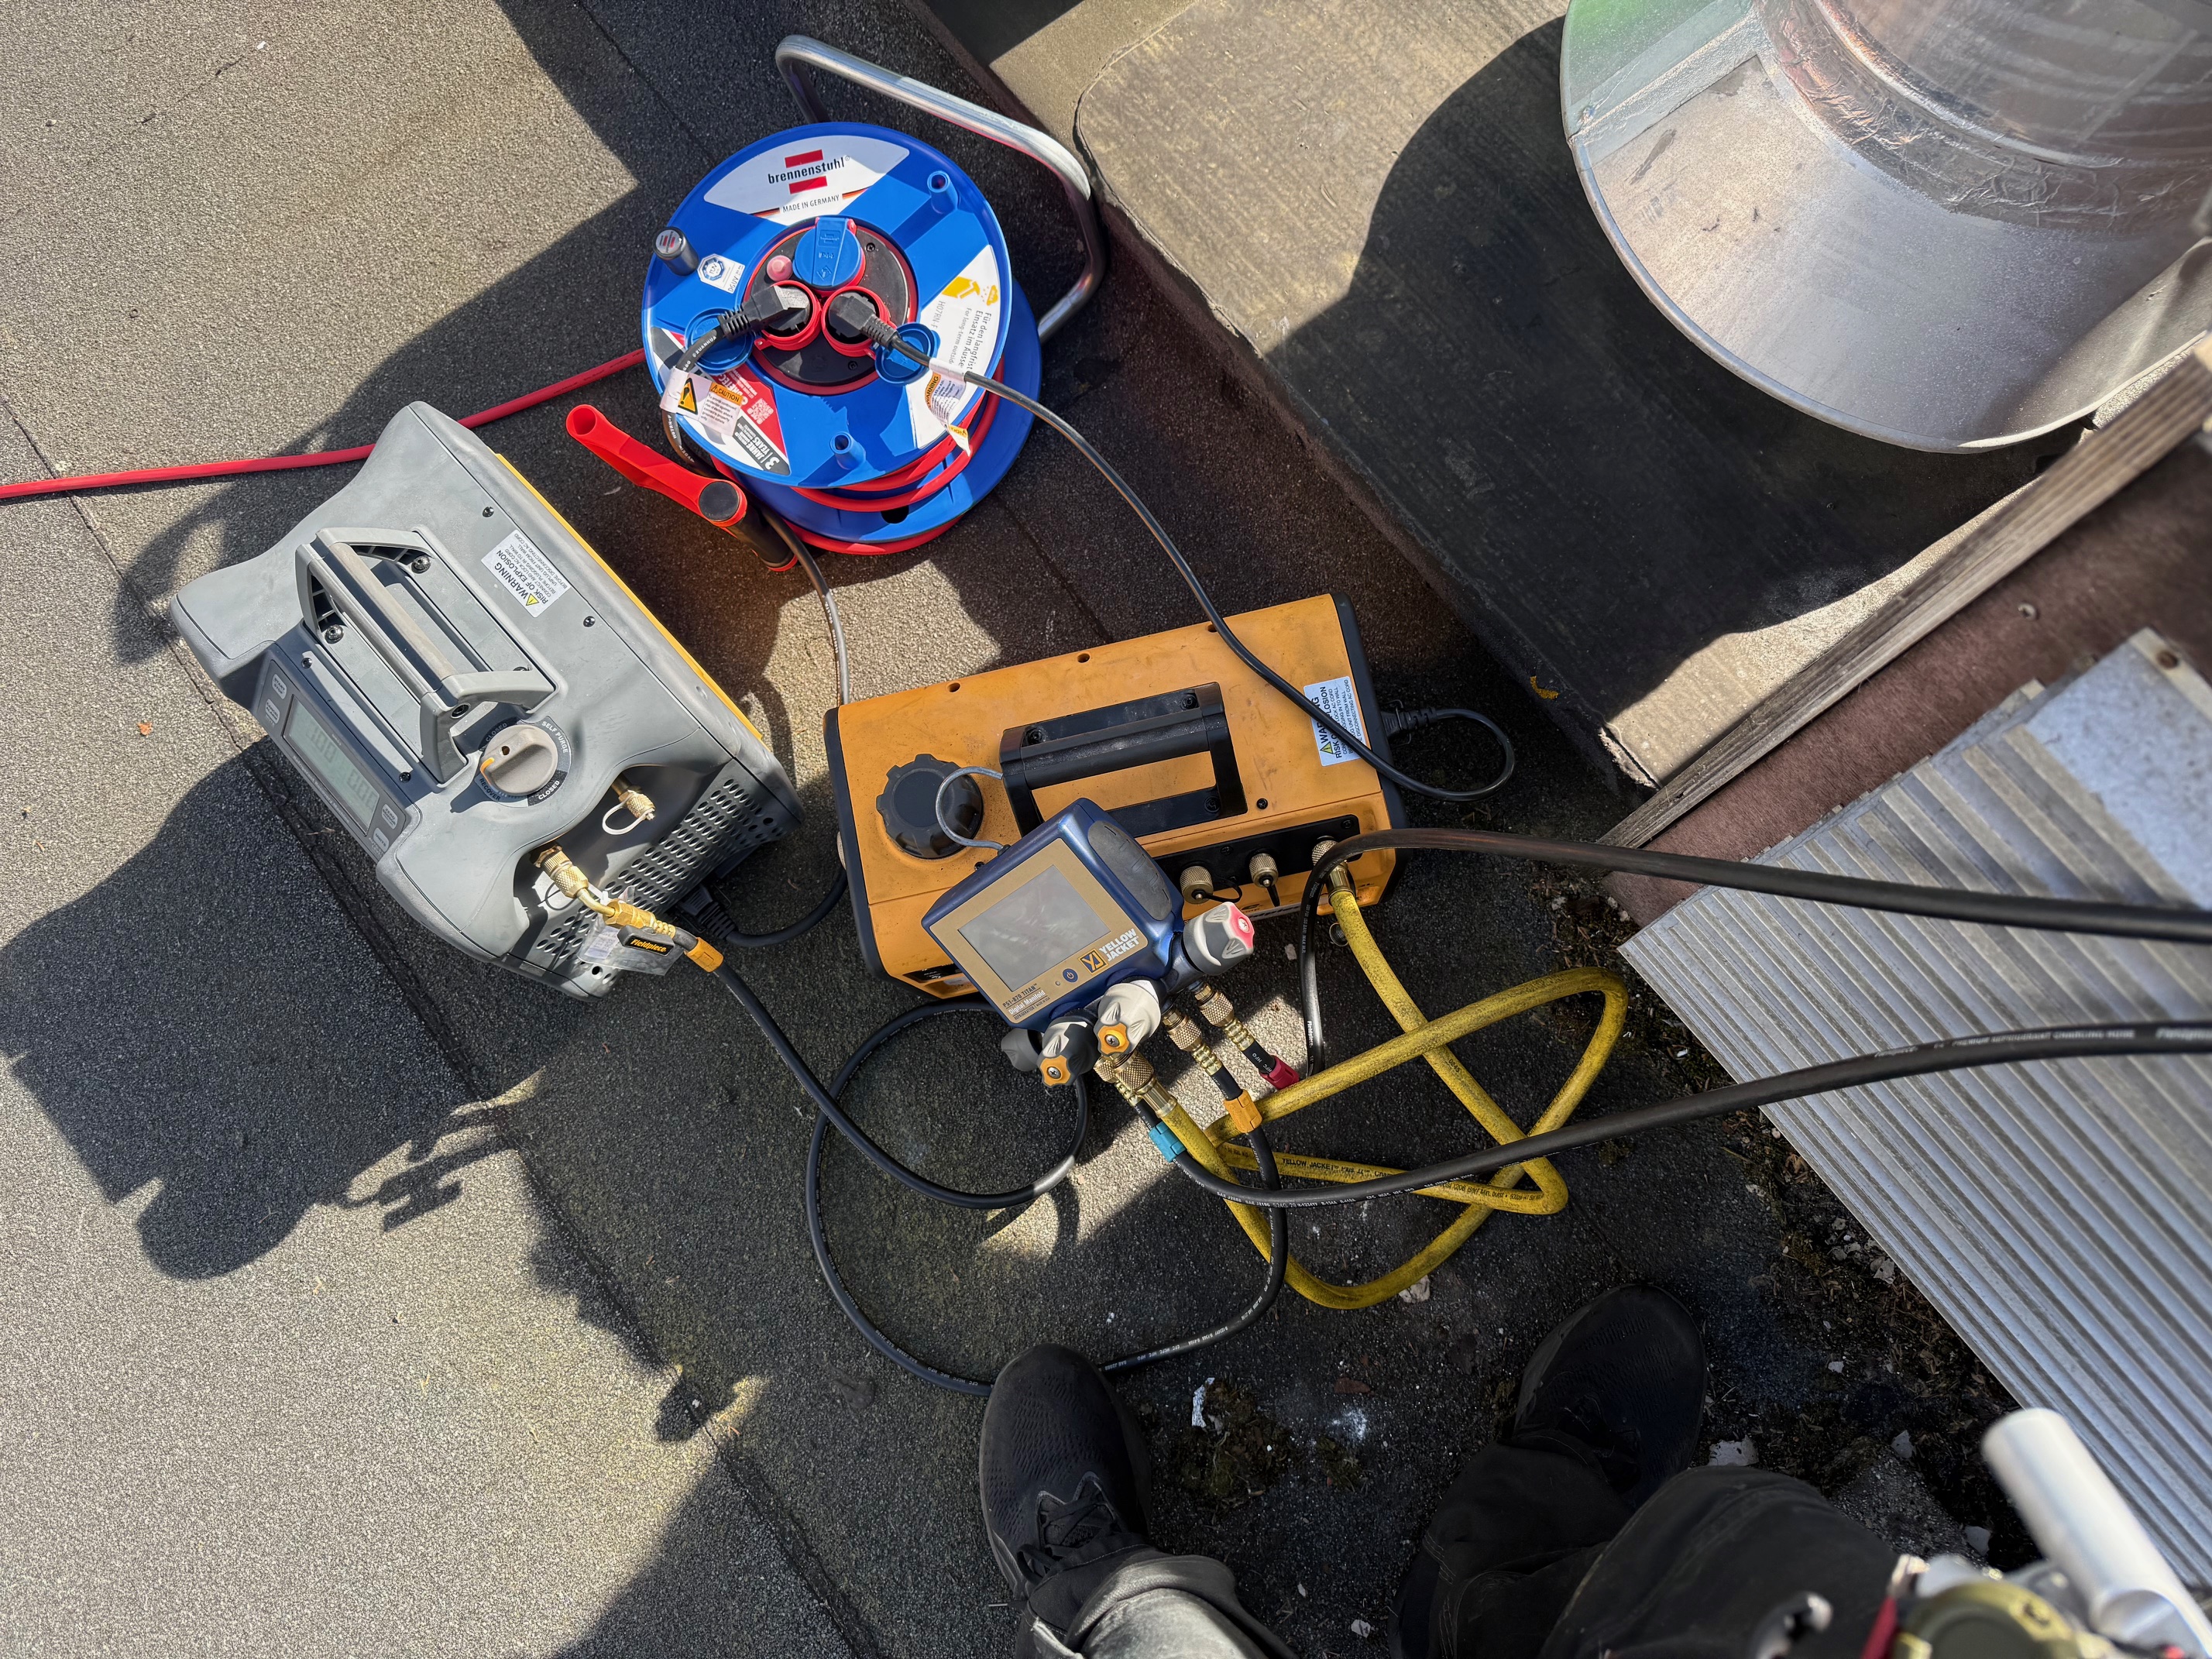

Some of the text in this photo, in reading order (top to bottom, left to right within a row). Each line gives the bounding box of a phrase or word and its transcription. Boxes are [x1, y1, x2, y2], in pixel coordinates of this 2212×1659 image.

[782, 203, 800, 213] MADE
[809, 194, 840, 207] GERMANY
[929, 300, 945, 328] H07RN-F
[953, 316, 968, 345] long-term
[957, 309, 983, 369] Einsatz im Ausse
[964, 311, 991, 371] Für den langfrist
[716, 388, 740, 402] CAUTION
[745, 441, 764, 461] JAHRE
[751, 434, 771, 455] YEARS
[763, 455, 780, 471] 3
[514, 532, 525, 544] CORD
[504, 548, 515, 559] CORD
[508, 544, 518, 555] WALL
[517, 543, 557, 586] UNPLUG UNIT FROM WALL
[518, 563, 529, 574] LOCK
[527, 546, 555, 576] DISCONNECTING
[493, 561, 529, 600] WARNING
[496, 548, 548, 604] RISK OF EXPLOSION
[525, 562, 544, 581] PLUGGING
[527, 572, 536, 581] AND
[553, 573, 568, 589] BEFORE
[534, 579, 551, 598] CONNECT
[541, 579, 555, 594] BEFORE
[1348, 699, 1362, 737] DISCONNECTING
[486, 723, 507, 742] CLOSED
[541, 720, 568, 753] SELF PURGE
[1332, 740, 1342, 758] RISK
[479, 778, 500, 800] RECOVER
[538, 780, 559, 799] CLOSED
[630, 938, 667, 953] Fieldpiece
[1098, 928, 1137, 955] YELLOW
[1008, 989, 1046, 1016] Digital Manifold
[1252, 1053, 1262, 1063] HFO
[1448, 1058, 1462, 1073] 0245
[1182, 1168, 1193, 1180] HFC
[1194, 1177, 1205, 1189] HFO
[885, 1338, 895, 1348] SAE
